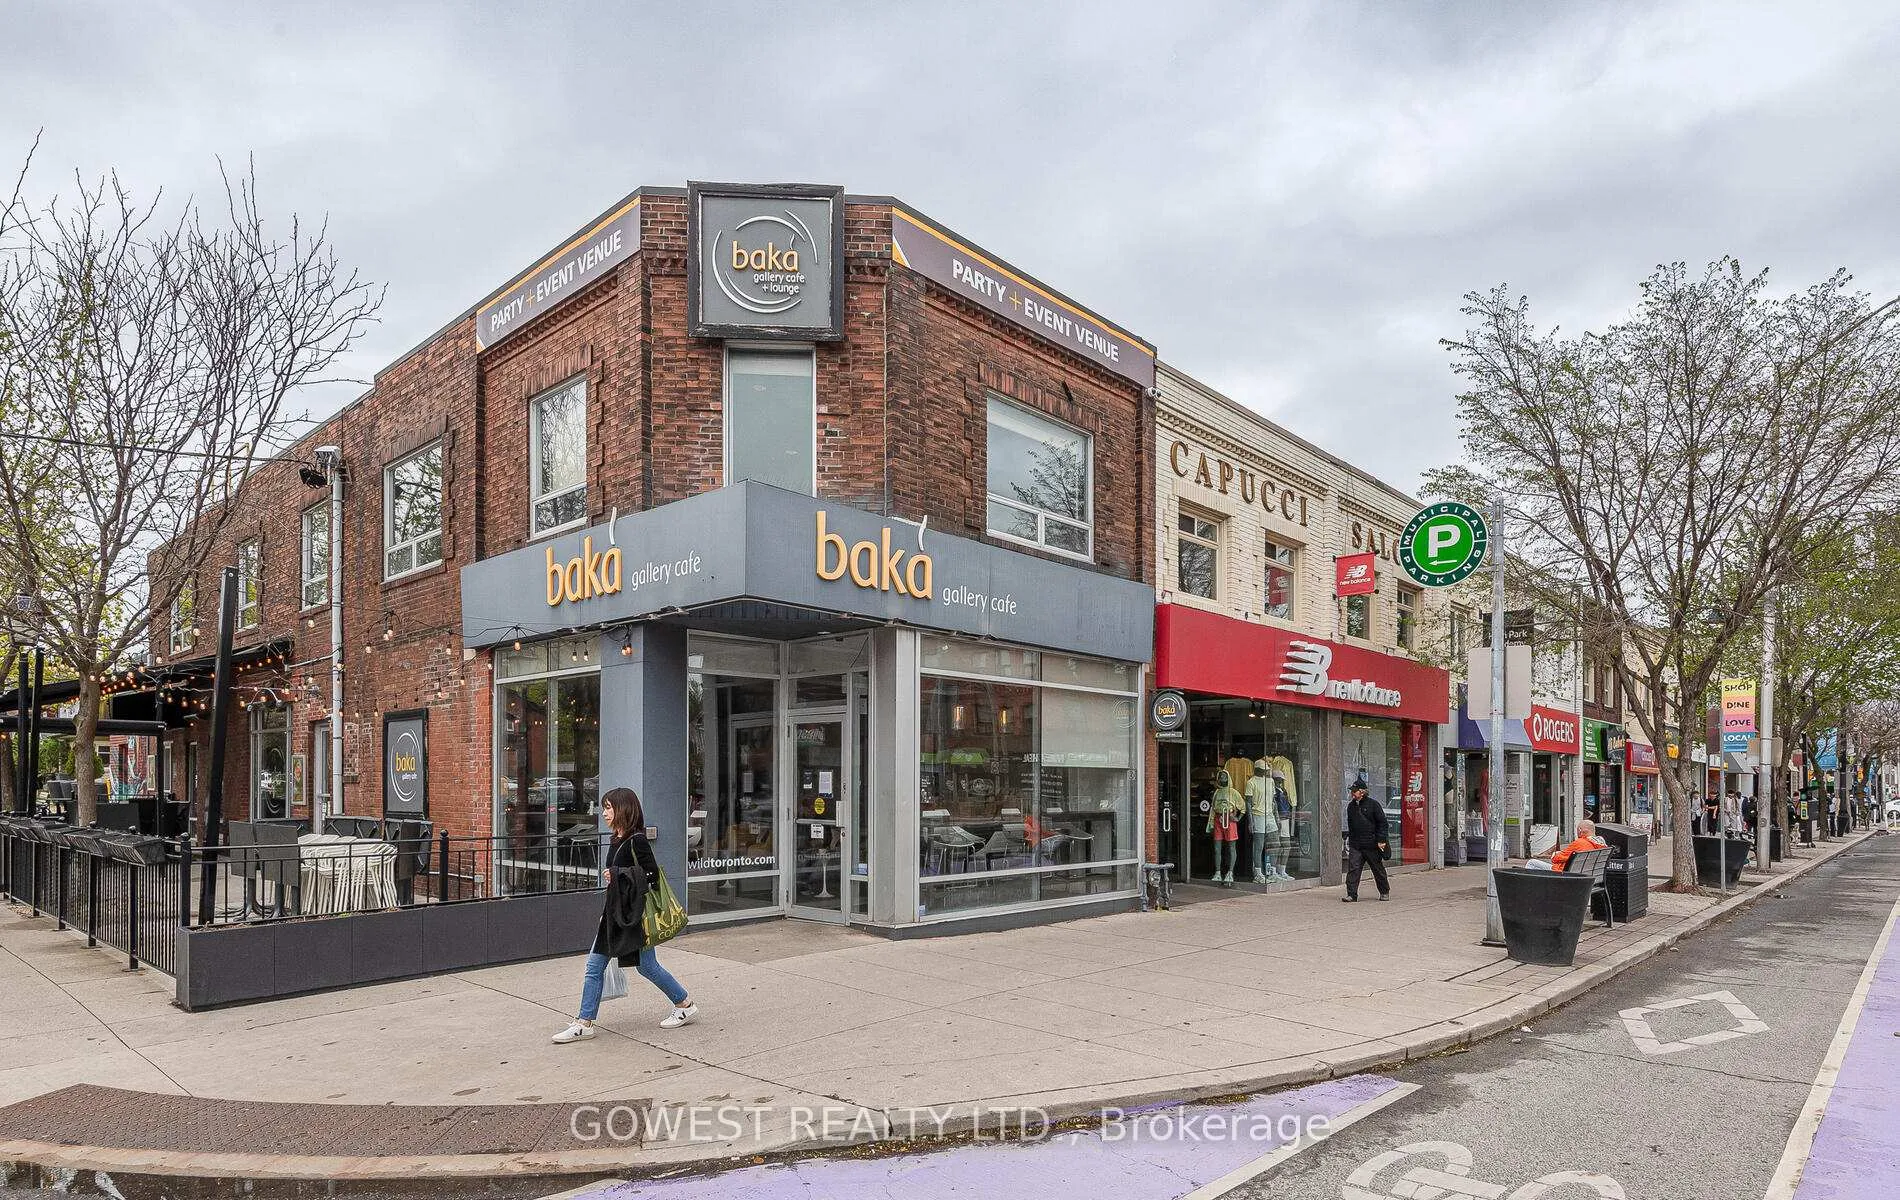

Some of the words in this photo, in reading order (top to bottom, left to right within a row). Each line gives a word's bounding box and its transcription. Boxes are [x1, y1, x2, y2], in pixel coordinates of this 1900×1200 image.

[732, 240, 798, 272] baka
[491, 294, 525, 332] PARTY
[536, 260, 576, 303] EVENT
[577, 229, 622, 274] VENUE
[753, 272, 784, 284] gallery
[785, 272, 805, 283] cafe
[770, 283, 800, 294] lounge
[952, 258, 1007, 303] PARTY
[1024, 297, 1074, 336] EVENT
[1074, 323, 1119, 362] VENUE
[1170, 440, 1308, 527] CAPUCCI
[1403, 505, 1483, 545] MUNICIPAL
[1428, 524, 1461, 558] P
[545, 536, 622, 606] baka
[631, 561, 672, 591] gallery
[674, 550, 701, 577] cafe
[816, 510, 933, 600] baka
[942, 585, 988, 612] gallery
[991, 594, 1017, 615] cafe
[1403, 550, 1482, 584] PARKING
[1508, 629, 1528, 639] Park
[1724, 683, 1753, 692] SHOP
[1726, 701, 1750, 709] DINE
[1543, 717, 1574, 744] ROGERS
[1725, 719, 1751, 727] LOVE
[395, 751, 416, 772] baka
